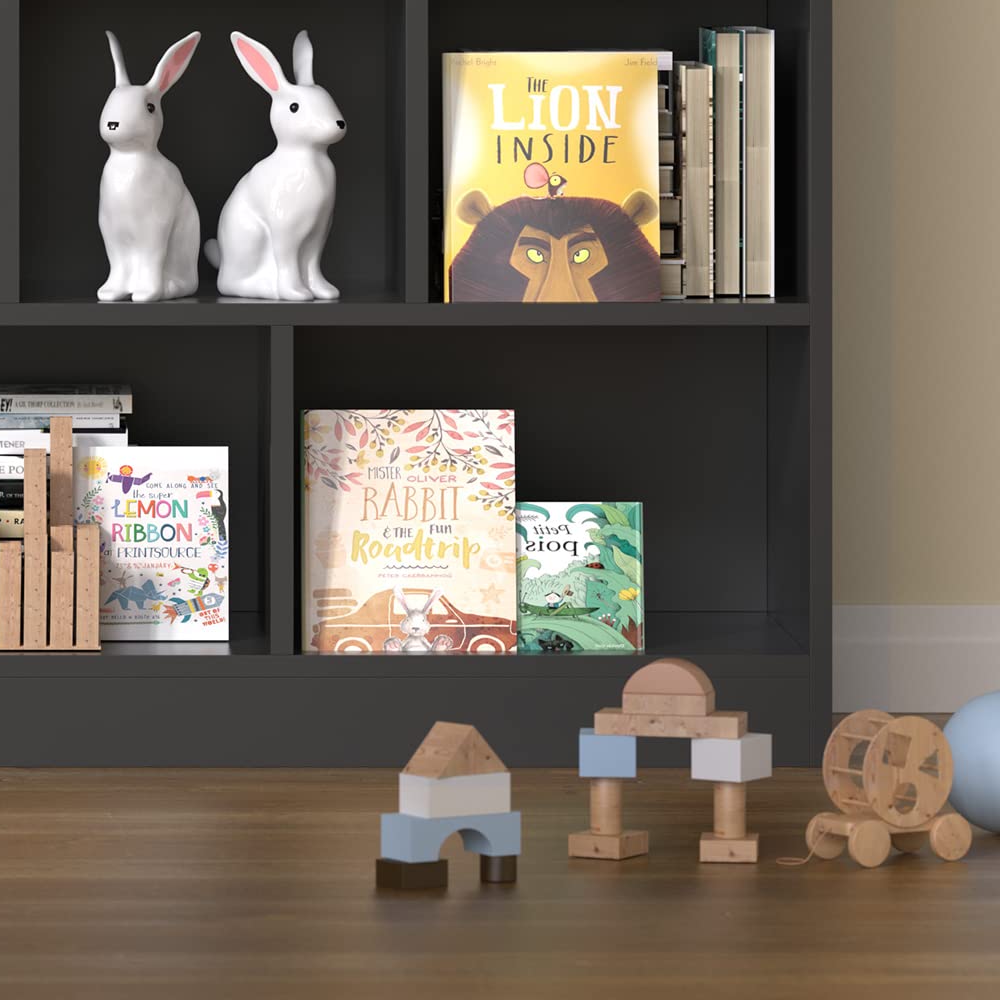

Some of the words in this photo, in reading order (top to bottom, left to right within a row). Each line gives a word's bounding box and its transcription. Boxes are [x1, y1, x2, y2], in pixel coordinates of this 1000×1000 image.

[526, 77, 549, 93] THE
[496, 134, 618, 164] INSIDE
[368, 466, 402, 480] MISTER
[406, 474, 457, 483] OLIVER
[133, 490, 146, 498] the
[148, 492, 173, 500] super
[360, 481, 464, 523] RABBIT
[111, 499, 189, 519] LEMON
[111, 523, 193, 543] RIBBON
[393, 526, 414, 538] THE
[117, 546, 202, 558] PRINTSOURCE
[350, 528, 481, 570] Roadtrip
